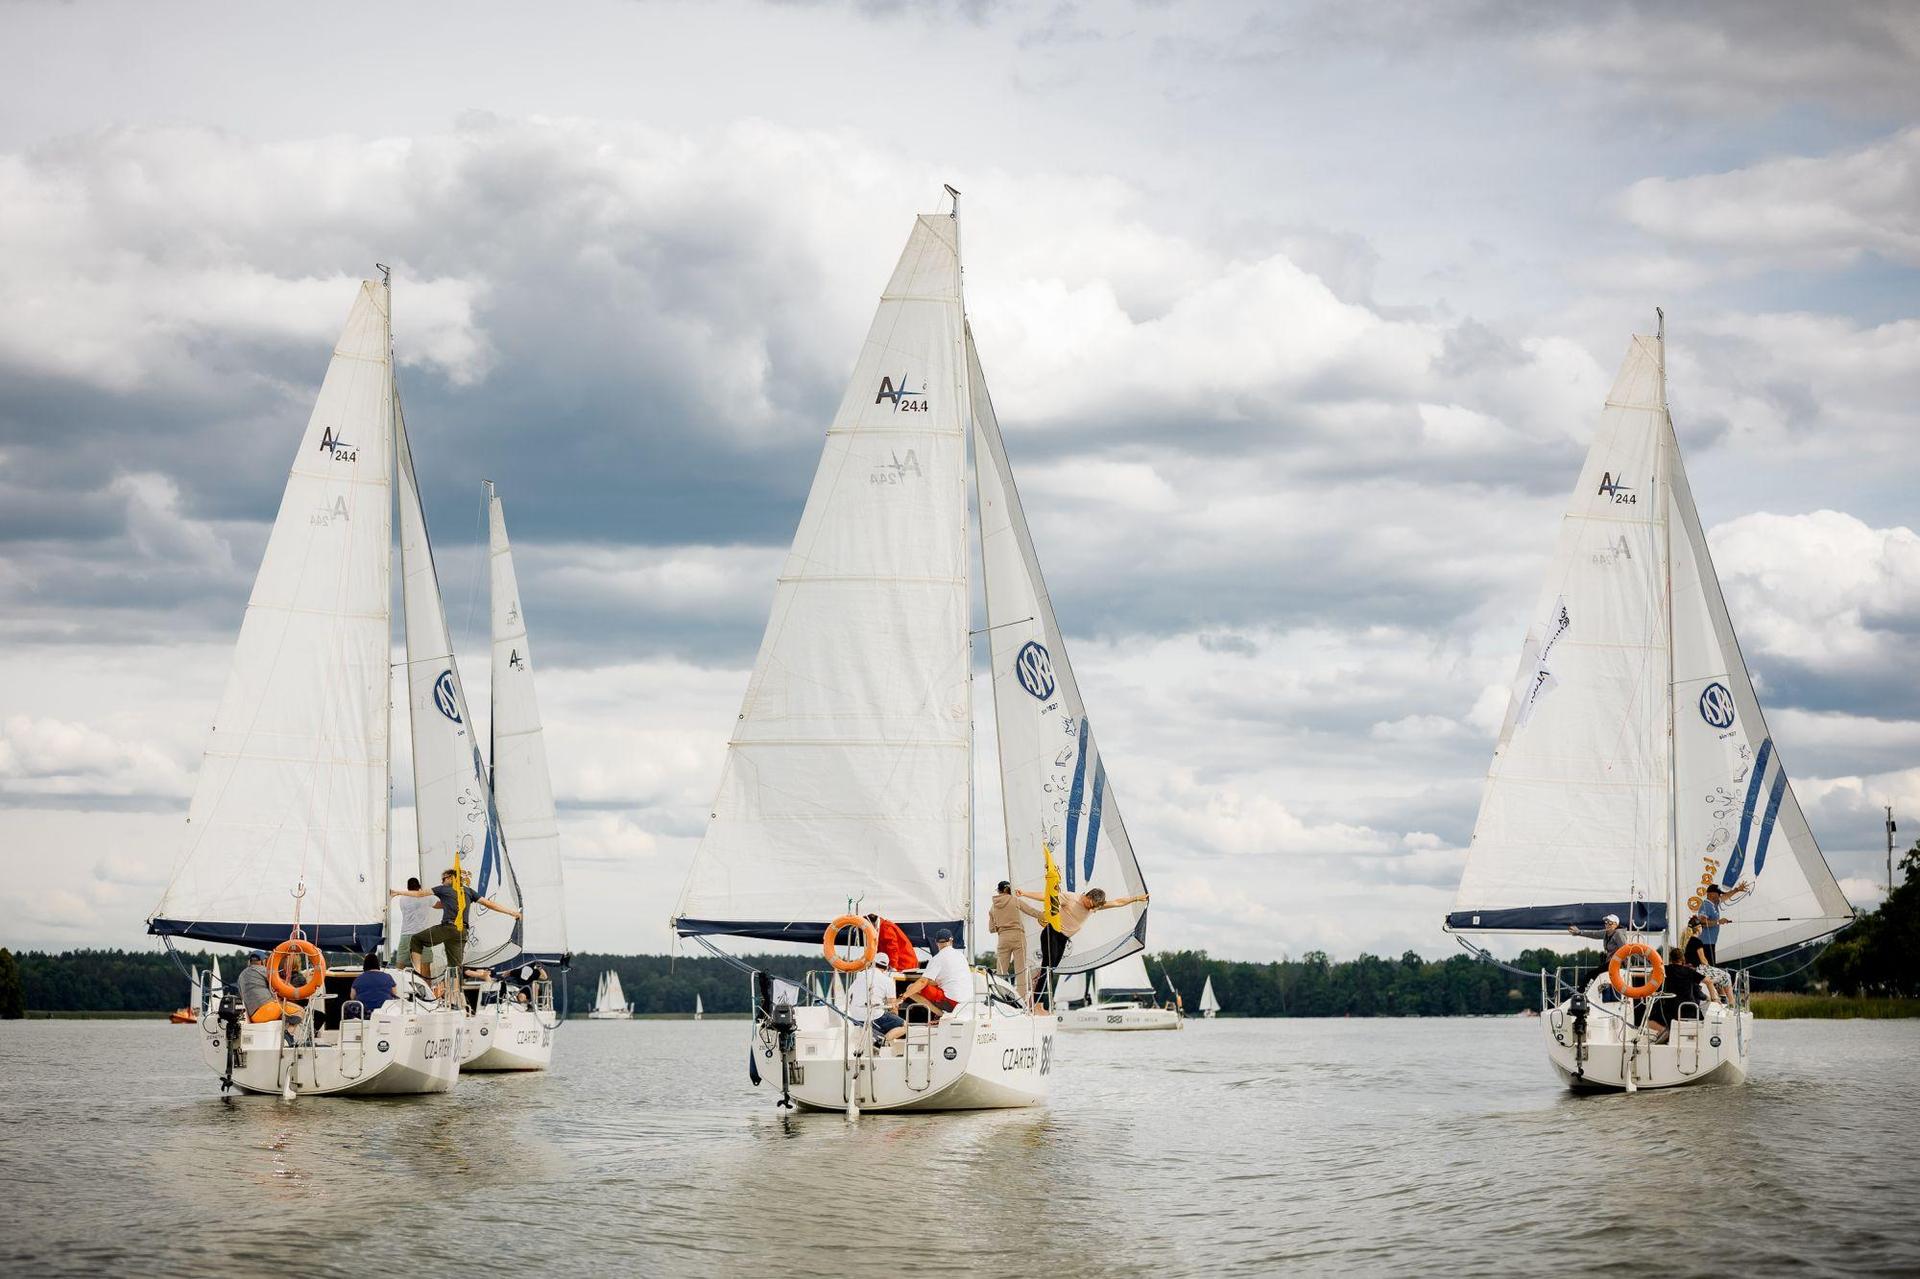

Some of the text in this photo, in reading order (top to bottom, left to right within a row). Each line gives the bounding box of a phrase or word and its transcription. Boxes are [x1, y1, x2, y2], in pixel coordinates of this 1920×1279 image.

[901, 400, 928, 412] 24.4
[335, 450, 356, 462] 24.4
[1615, 493, 1637, 505] 24.4
[1001, 1047, 1039, 1071] CZARTERY
